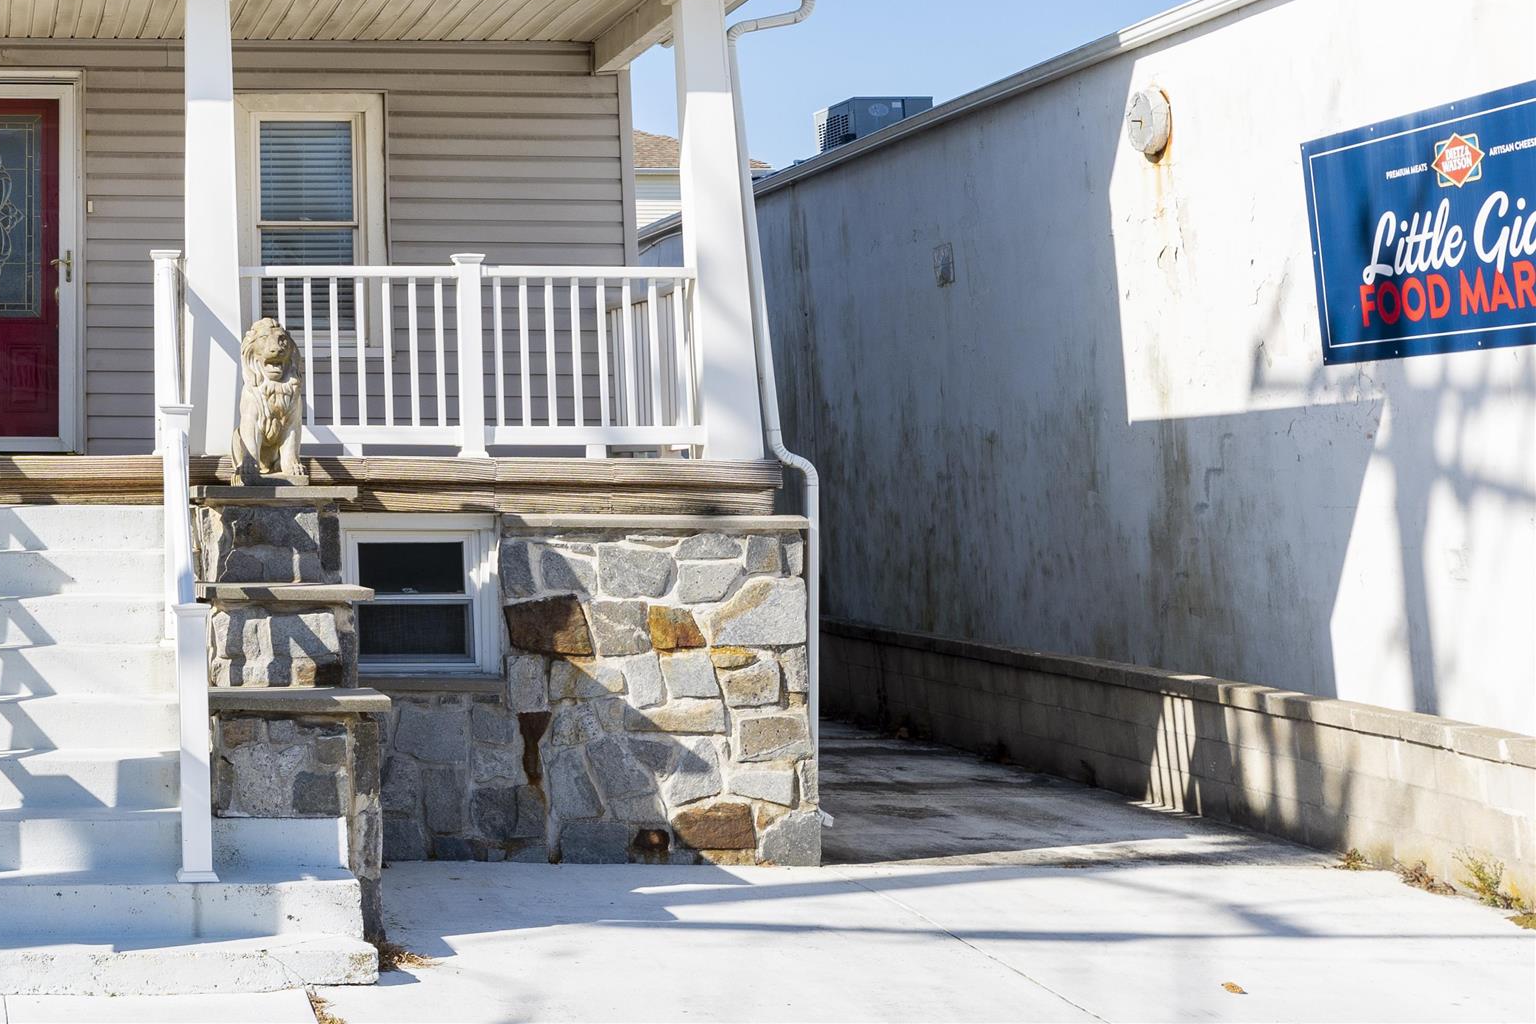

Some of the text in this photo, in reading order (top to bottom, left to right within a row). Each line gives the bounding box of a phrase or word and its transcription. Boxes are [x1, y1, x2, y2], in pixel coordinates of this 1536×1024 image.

[1489, 141, 1515, 156] ARTISAN
[1385, 162, 1428, 180] PREMIUM MEATS
[1441, 152, 1473, 173] WATSON
[1362, 197, 1467, 285] Little
[1359, 260, 1536, 328] FOOD MAR
